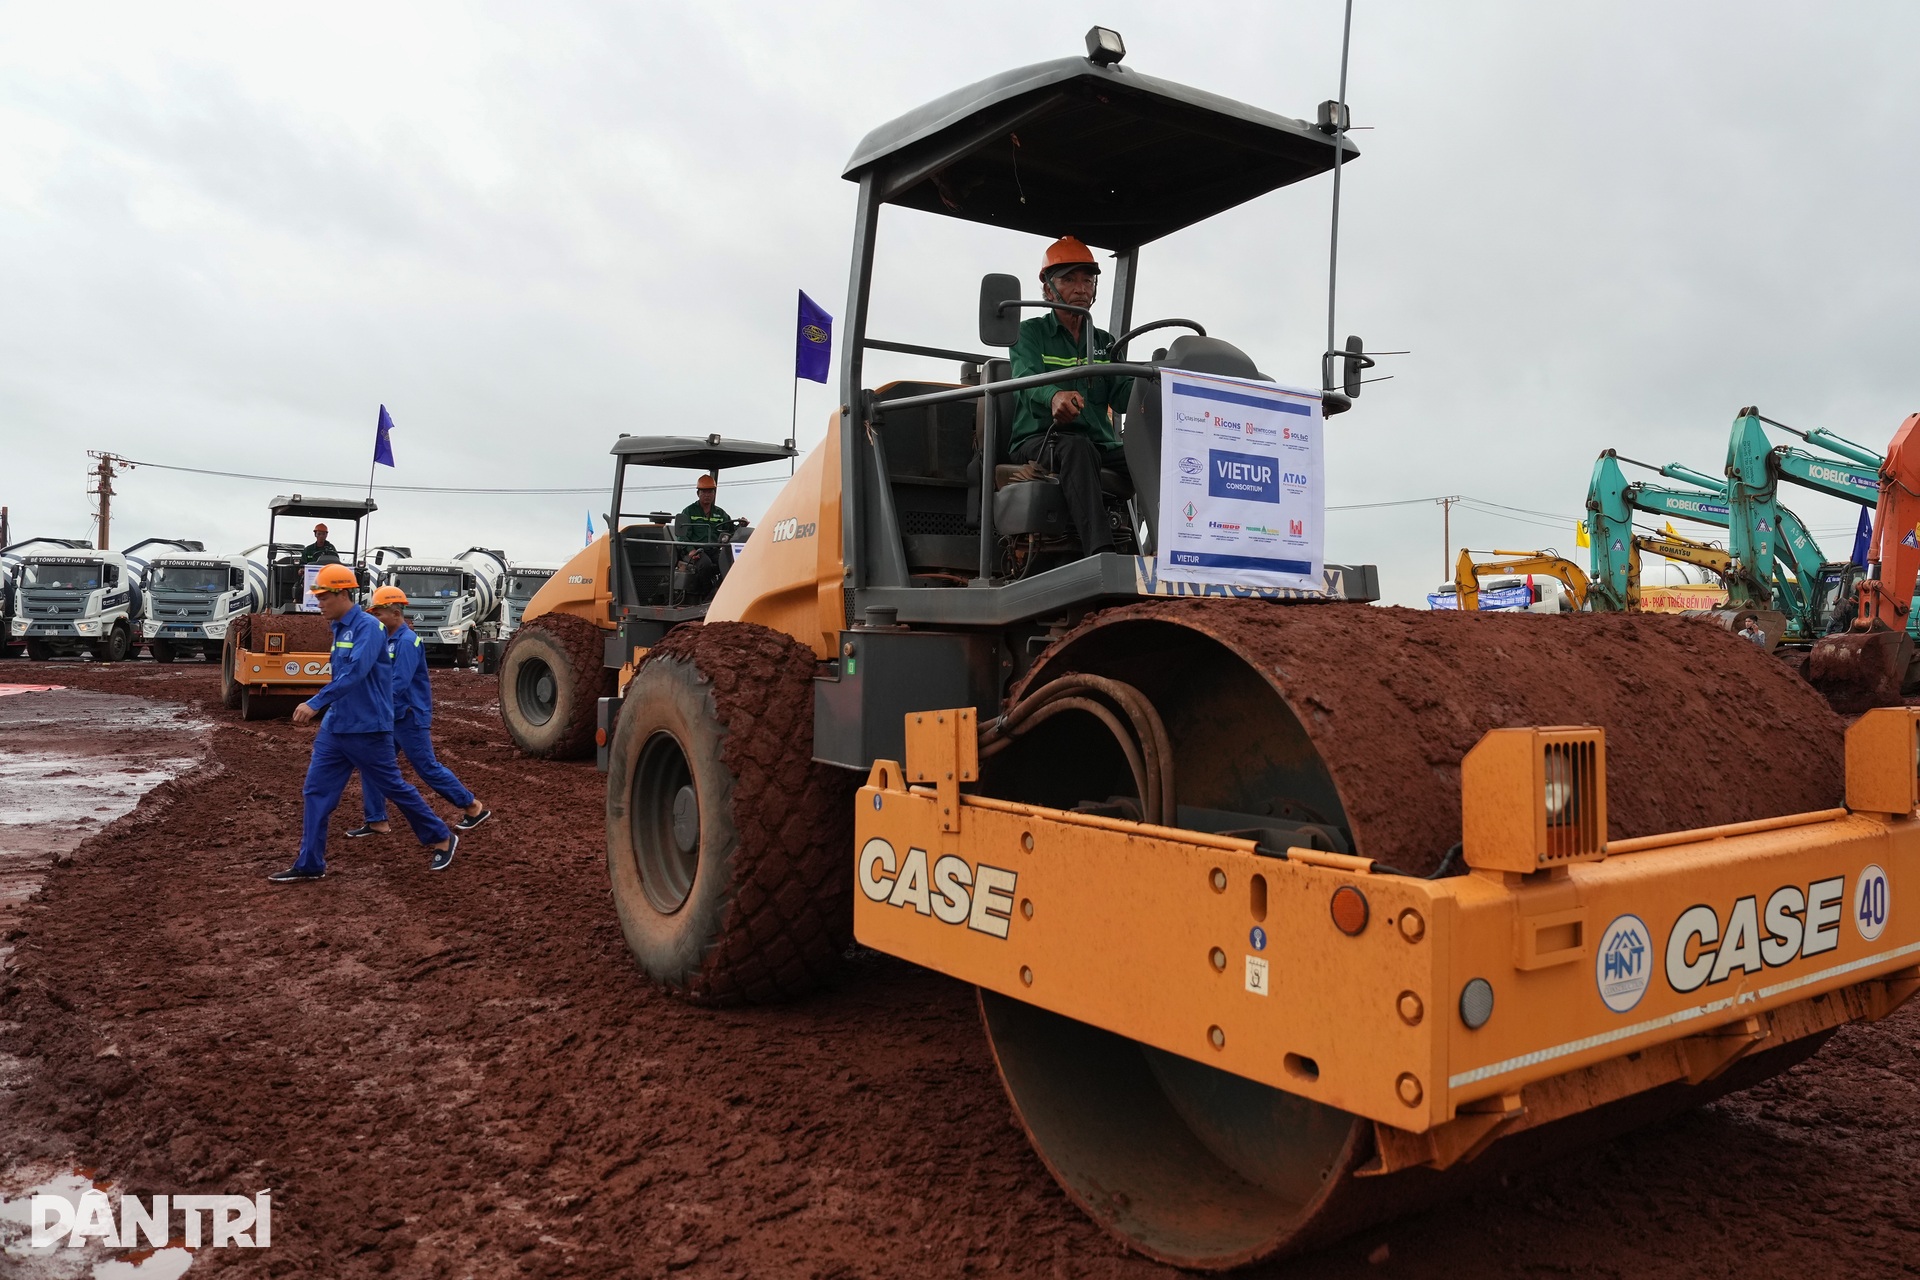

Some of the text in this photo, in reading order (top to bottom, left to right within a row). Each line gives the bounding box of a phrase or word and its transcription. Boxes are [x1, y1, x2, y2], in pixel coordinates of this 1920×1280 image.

[1216, 460, 1272, 484] VIETUR
[1283, 473, 1307, 485] ATAD
[1225, 482, 1263, 493] CONSORTIUM
[1176, 554, 1200, 564] VIETUR
[1659, 545, 1691, 557] KOMATSU
[858, 836, 1018, 940] CASE
[1859, 876, 1885, 927] 40
[1664, 875, 1845, 994] CASE
